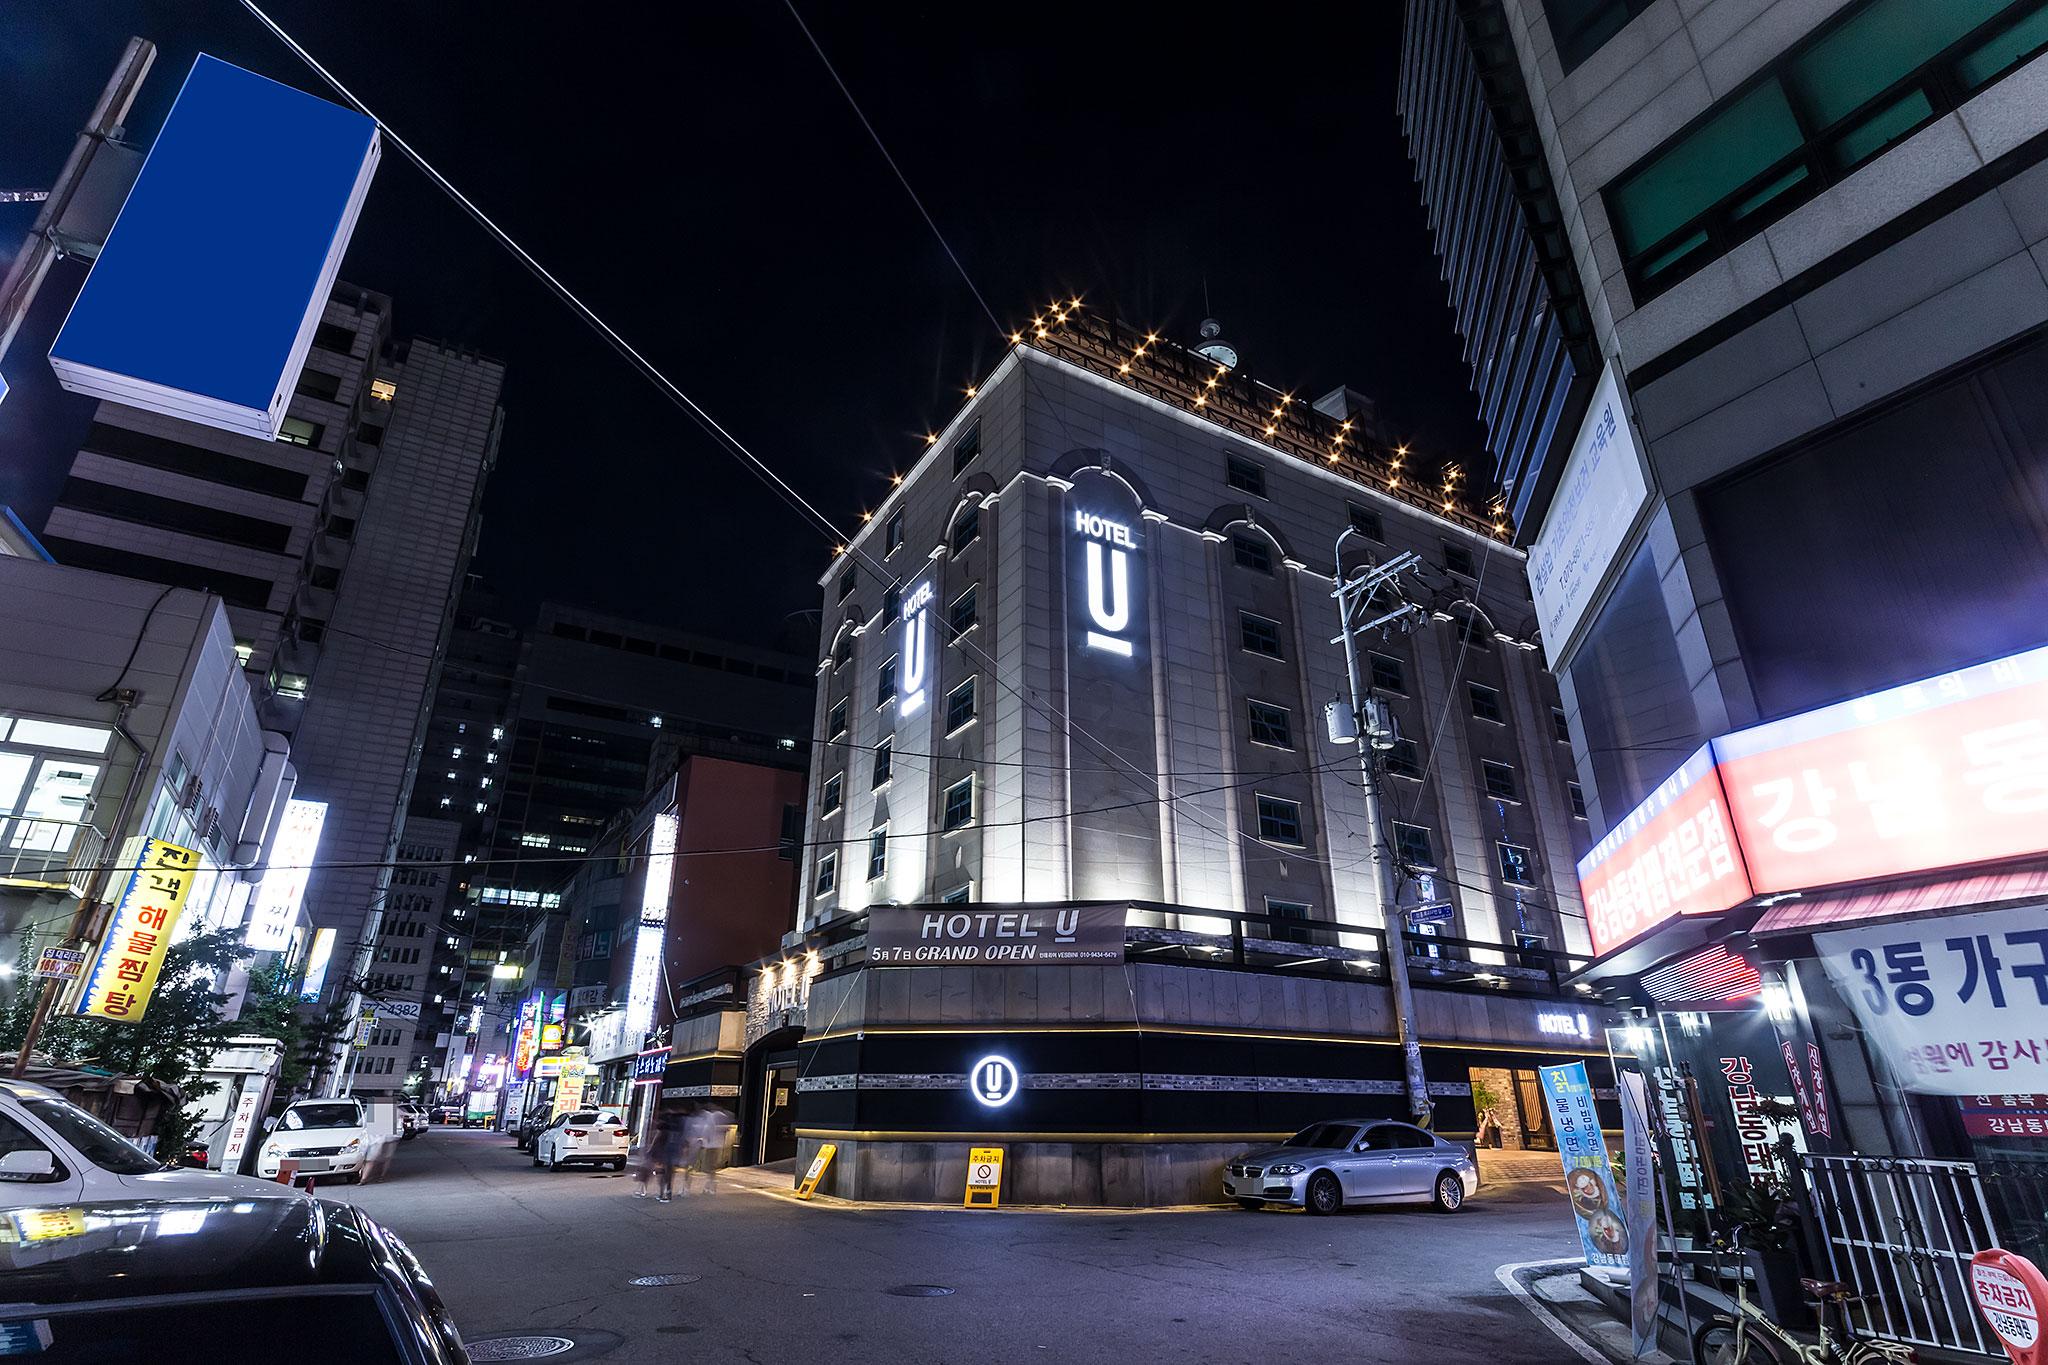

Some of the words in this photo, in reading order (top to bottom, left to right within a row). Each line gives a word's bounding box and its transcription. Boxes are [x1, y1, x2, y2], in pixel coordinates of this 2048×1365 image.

[1589, 402, 1617, 474] 교육원
[1075, 510, 1137, 549] HOTEL
[903, 581, 934, 620] HOTEL
[1087, 541, 1130, 633] U
[904, 608, 926, 694] U
[920, 913, 1039, 940] HOTEL
[1055, 909, 1080, 936] U
[871, 947, 889, 961] 5月
[892, 947, 912, 961] 7日
[915, 946, 979, 961] GRAND
[985, 945, 1037, 961] OPEN
[767, 981, 798, 1016] HOTEL
[1850, 941, 1935, 1017] 3동
[1538, 1012, 1579, 1035] HOTEL
[1977, 1039, 2048, 1071] 감사
[985, 1063, 1002, 1093] U
[228, 1096, 254, 1155] 주차금지
[1556, 1097, 1580, 1153] 물냉면
[1576, 1095, 1600, 1153] 비빔냉면
[1976, 1280, 2032, 1312] 주차금지
